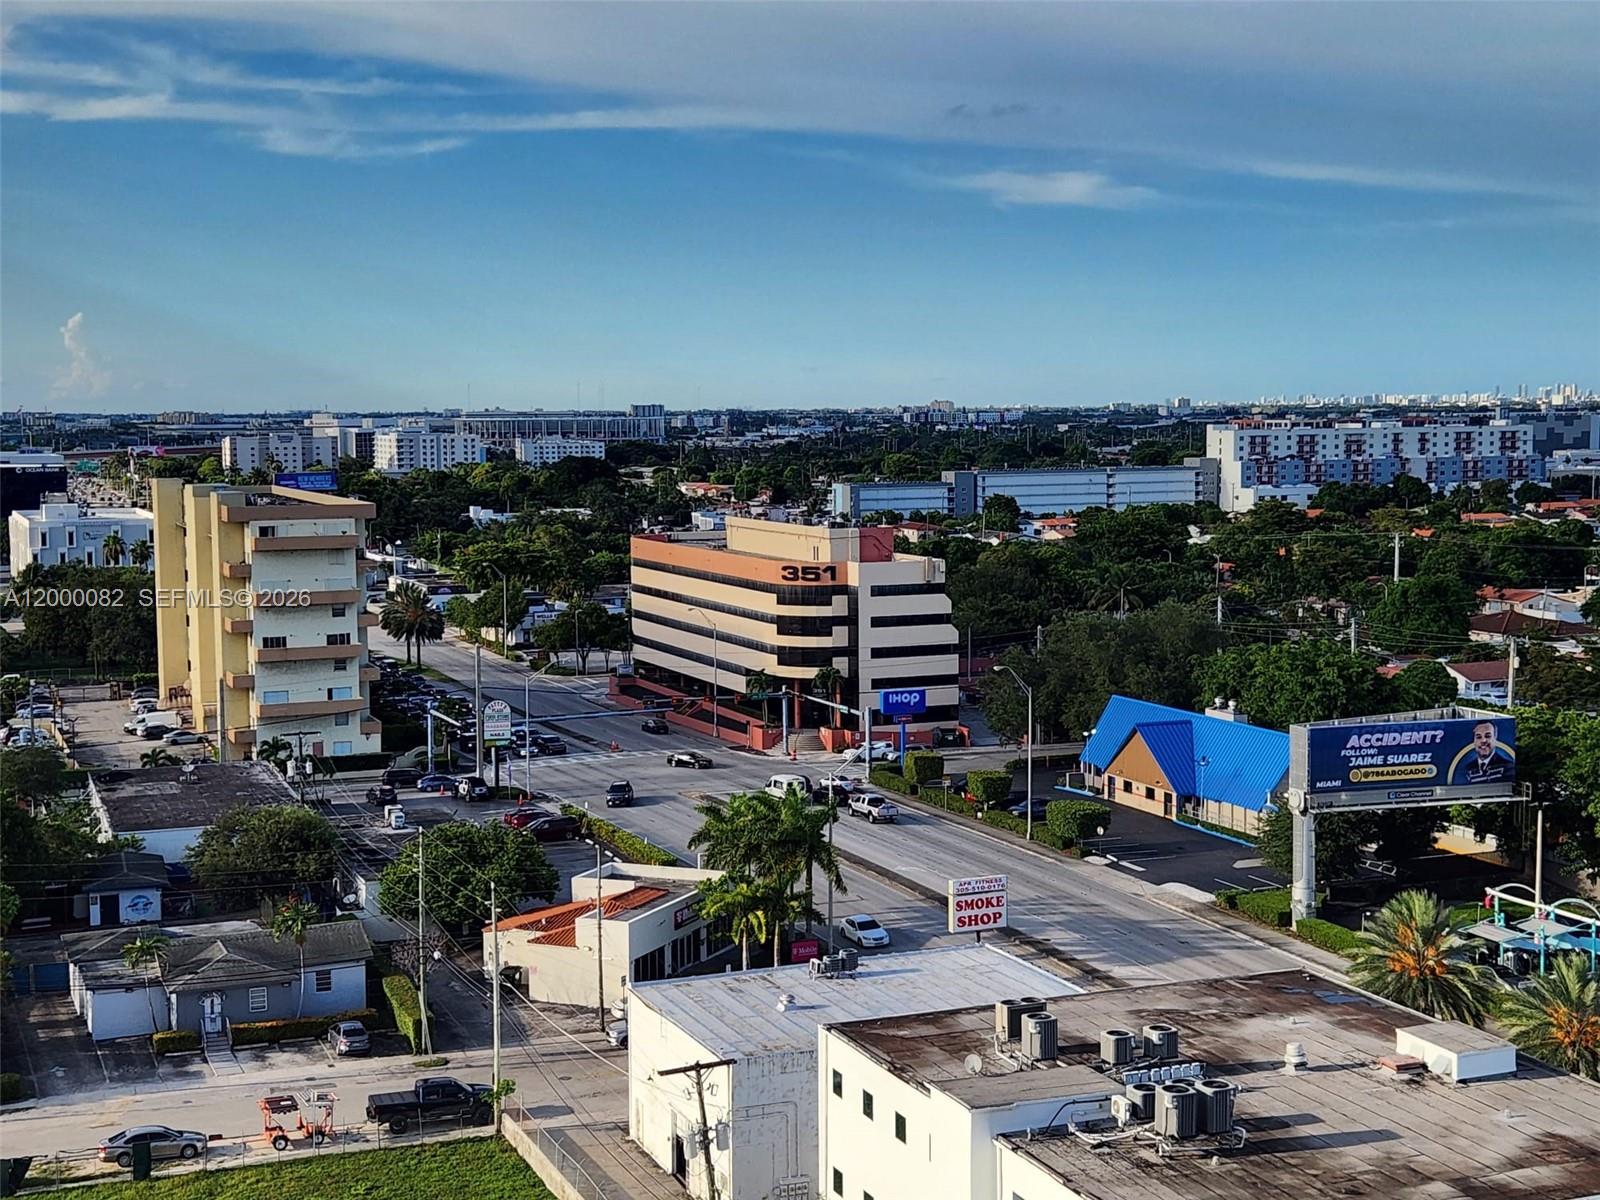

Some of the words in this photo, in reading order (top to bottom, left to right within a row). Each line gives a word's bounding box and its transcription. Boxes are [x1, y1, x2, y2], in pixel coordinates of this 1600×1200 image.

[781, 565, 837, 582] 351
[1346, 730, 1444, 748] ACCIDENT?
[1340, 748, 1378, 757] FOLLOW:
[1348, 755, 1384, 767] JAIME
[1386, 752, 1432, 764] SUAREZ
[1362, 767, 1427, 779] @786ABOGADO
[1315, 780, 1342, 788] MIAMI
[955, 895, 1005, 912] SMOKE
[956, 911, 1003, 928] SHOP
